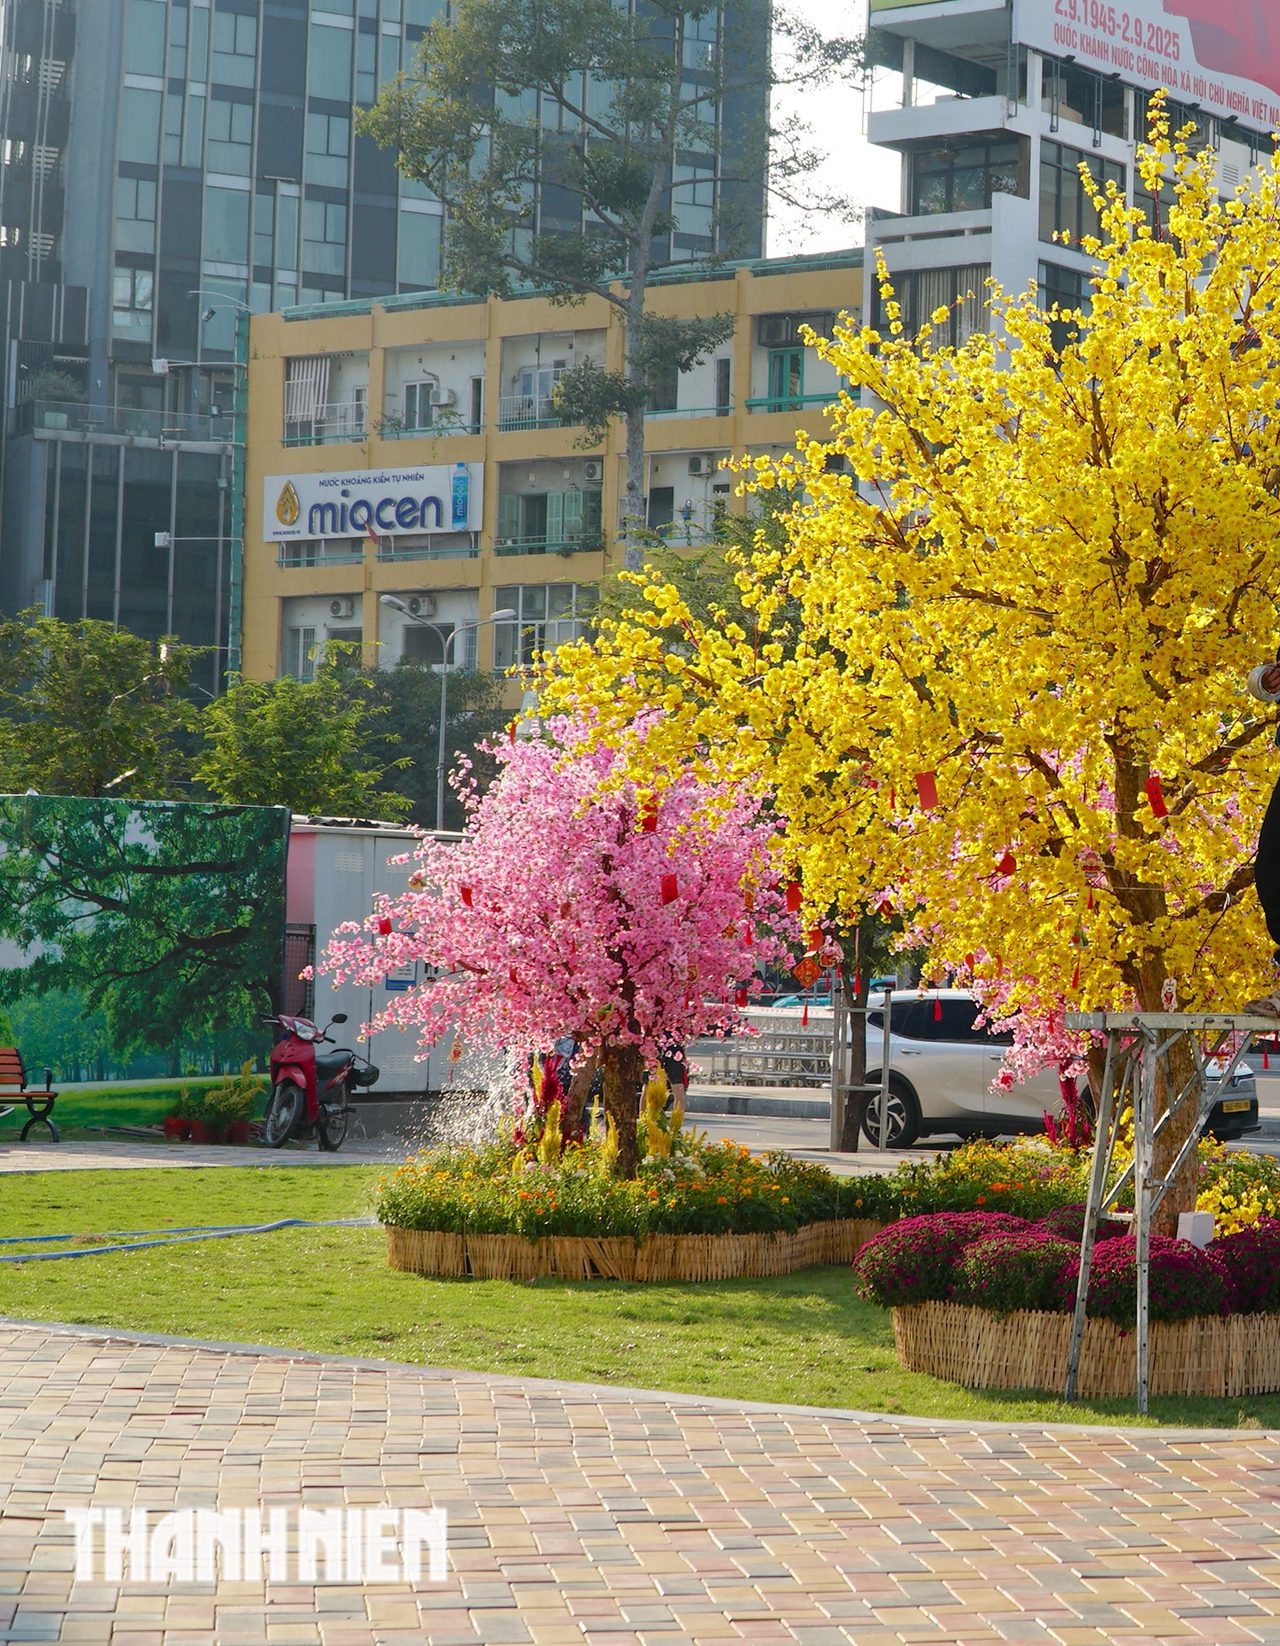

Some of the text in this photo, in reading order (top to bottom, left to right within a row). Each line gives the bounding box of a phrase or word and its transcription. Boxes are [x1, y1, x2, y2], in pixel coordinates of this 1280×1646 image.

[1054, 21, 1077, 49] QUỐC
[1080, 32, 1109, 62] KHÁNH
[1111, 44, 1134, 72] NƯỚC
[1136, 53, 1159, 80] CỘNG
[1161, 62, 1178, 88] HÒA
[1180, 70, 1191, 93] XÃ
[1193, 75, 1207, 102] HỘI
[1209, 81, 1225, 106] CHỦ
[1226, 89, 1250, 115] NGHĨA
[1252, 98, 1268, 124] VIỆT
[341, 475, 372, 486] KHOÁNG
[402, 472, 425, 482] NHIÊN
[308, 488, 444, 535] miocen
